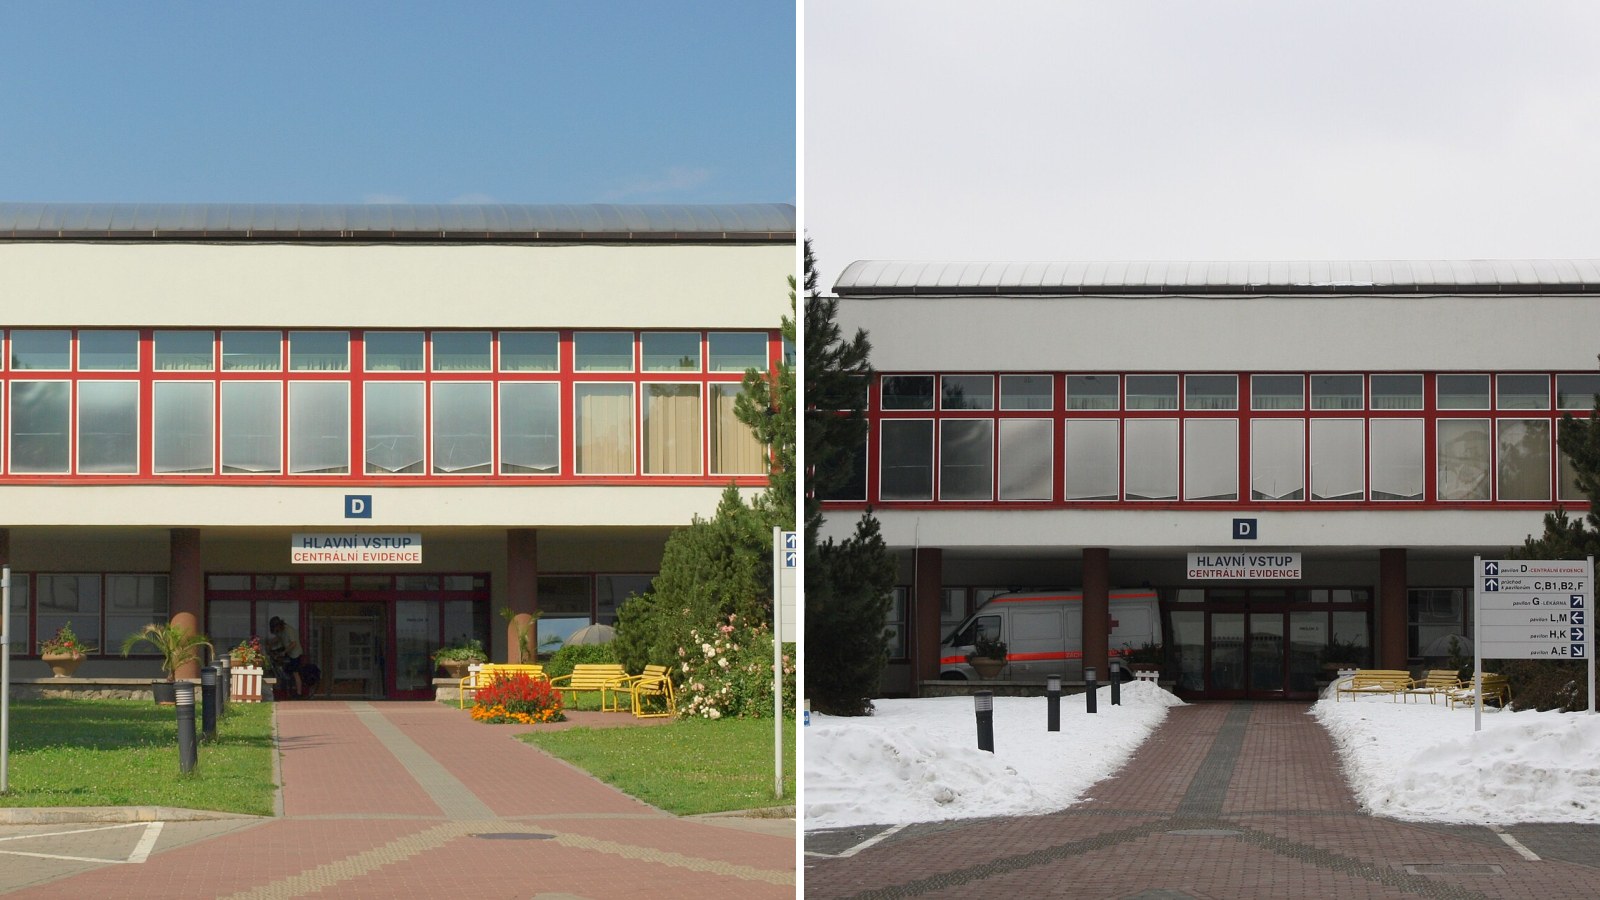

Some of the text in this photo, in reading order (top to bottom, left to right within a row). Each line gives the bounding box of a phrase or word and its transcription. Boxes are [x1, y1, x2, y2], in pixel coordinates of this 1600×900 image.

[351, 498, 365, 514] D
[1240, 522, 1251, 536] D
[303, 534, 412, 549] HLAVNÍ VSTUP
[293, 550, 419, 562] CENTRÁLNÍ EVIDENCE
[1197, 553, 1293, 567] HLAVNÍ VSTUP
[1188, 567, 1300, 578] CENTRÁLNÍ EVIDENCE
[1520, 564, 1528, 573] D
[1532, 597, 1540, 606] G
[1550, 613, 1567, 623] L,M
[1549, 630, 1567, 640] H,K
[1551, 646, 1567, 655] A,E
